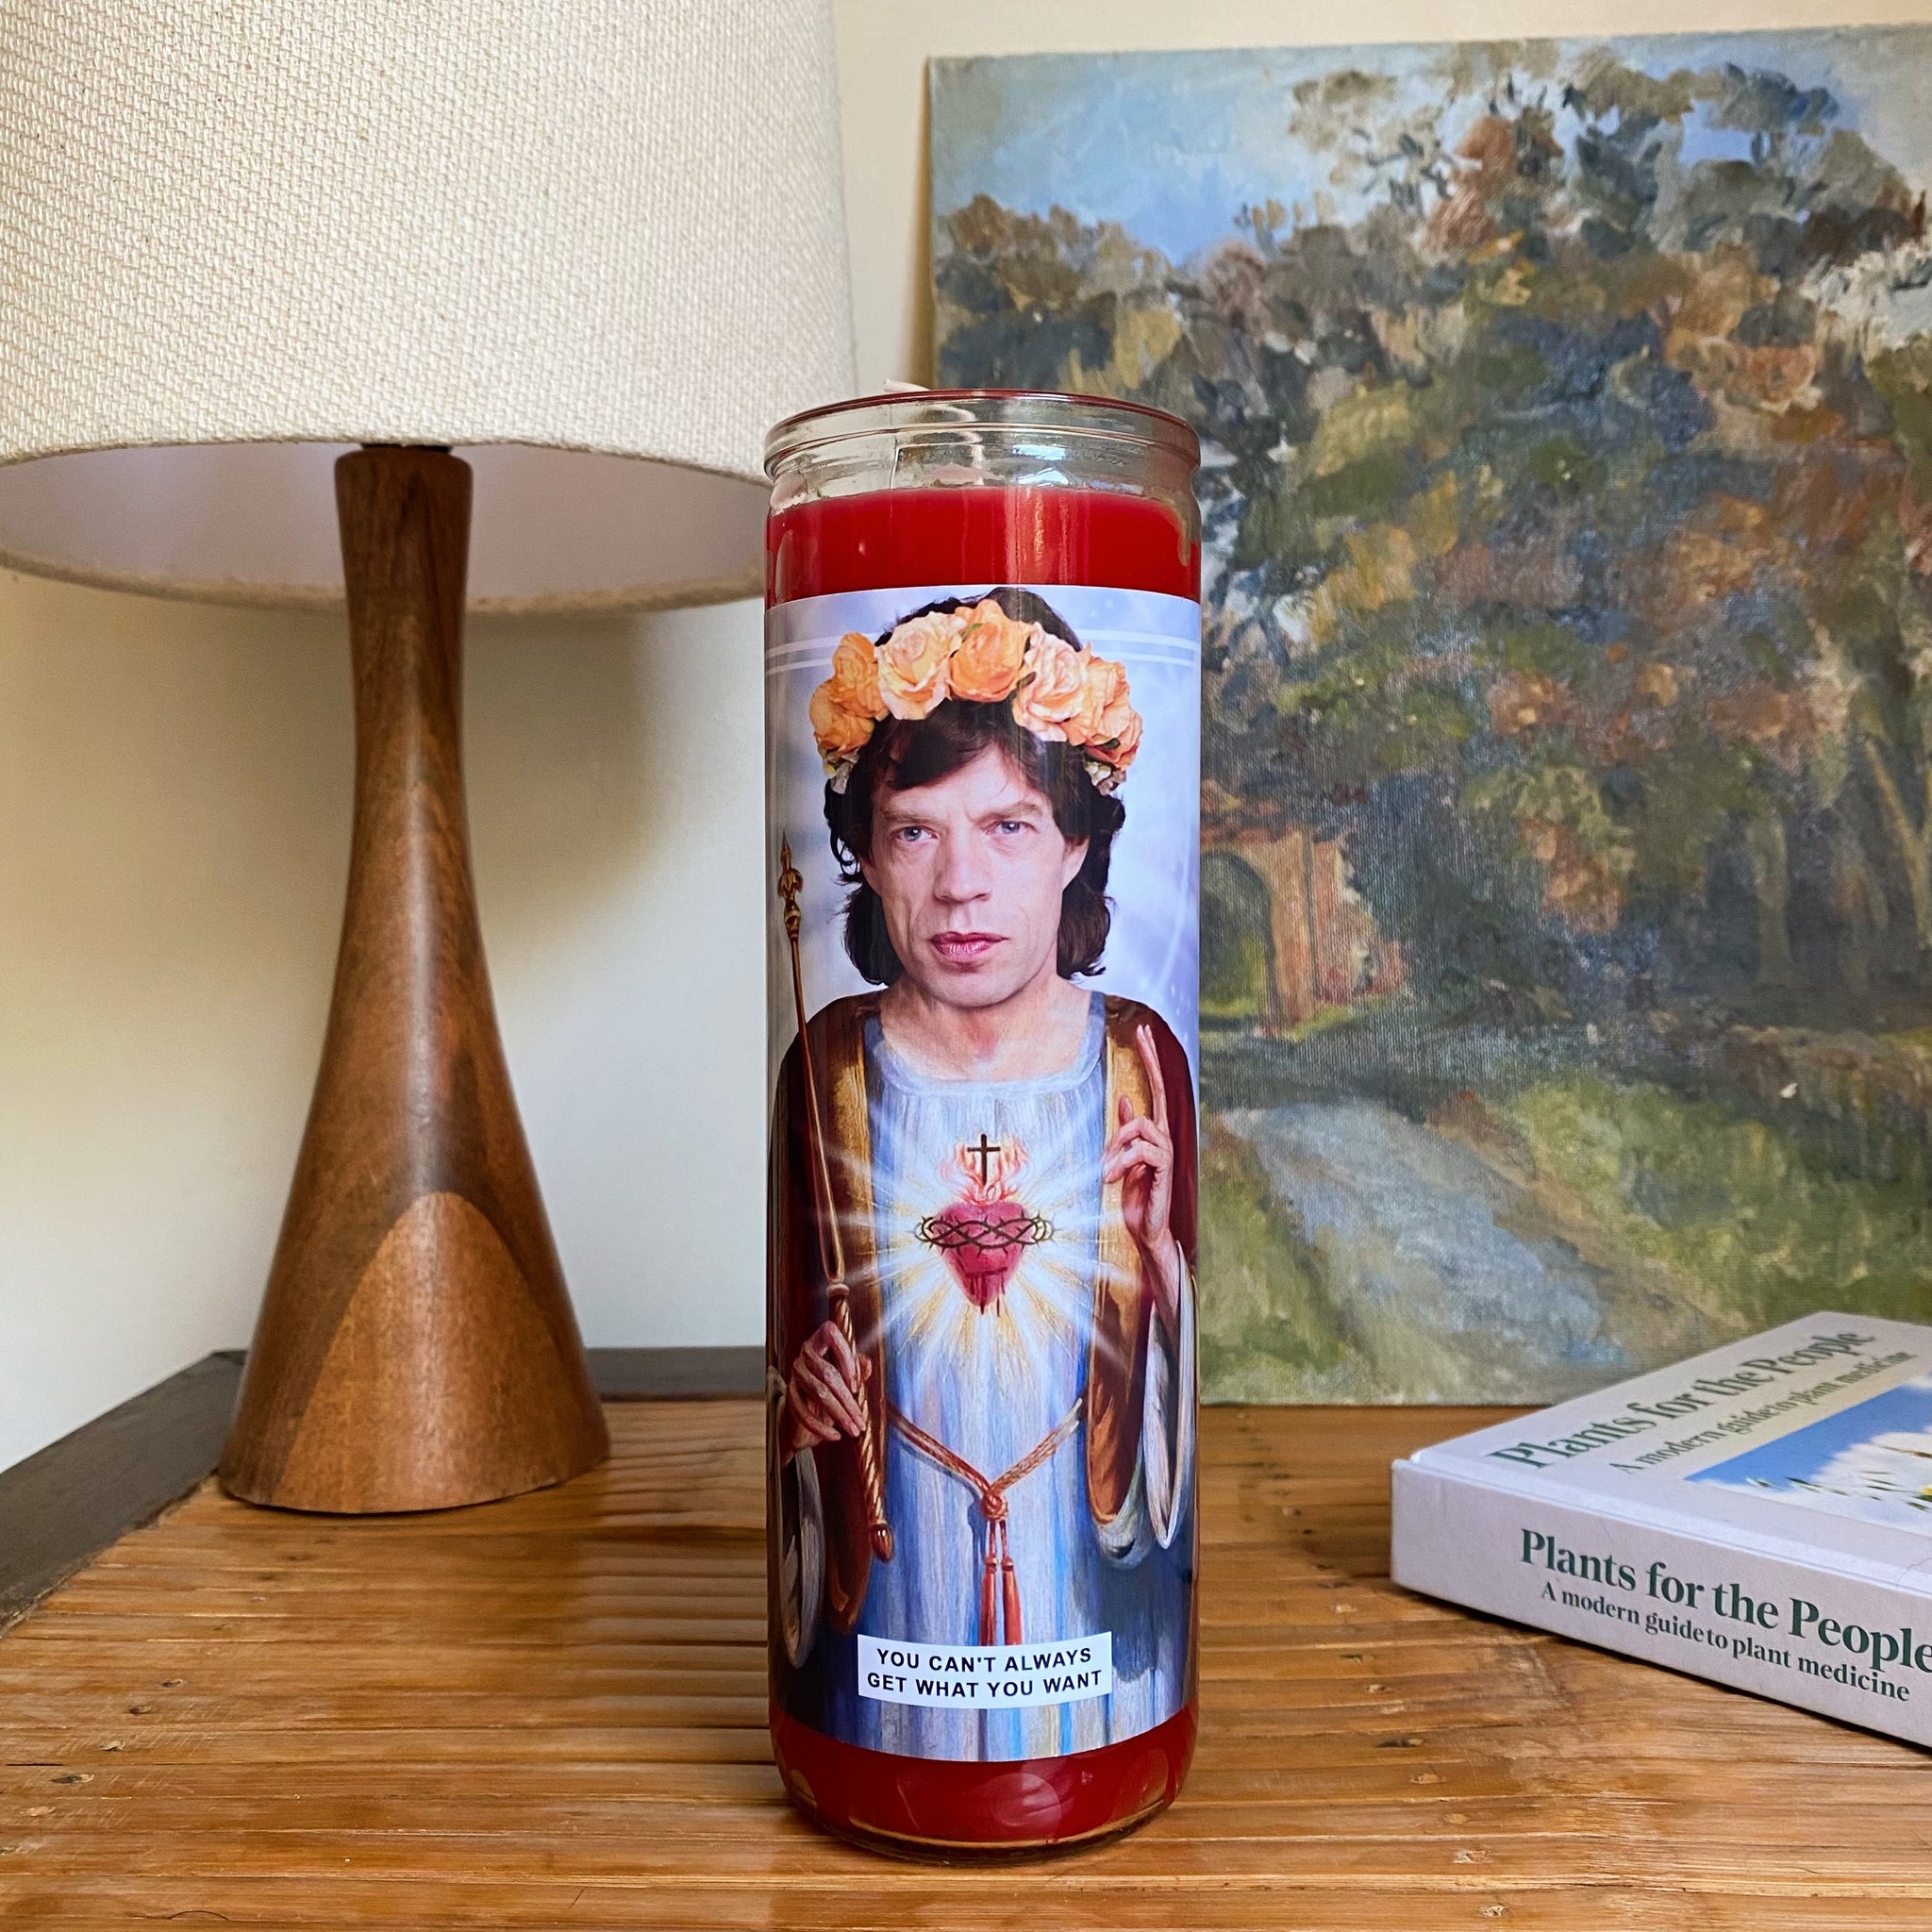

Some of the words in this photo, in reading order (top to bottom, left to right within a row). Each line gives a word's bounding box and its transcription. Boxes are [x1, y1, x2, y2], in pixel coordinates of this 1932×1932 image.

[1485, 1417, 1657, 1469] Plants
[1627, 1393, 1717, 1420] for
[1691, 1369, 1775, 1397] the
[1740, 1332, 1876, 1374] People
[1609, 1461, 1644, 1475] A
[1636, 1429, 1727, 1466] modern
[1521, 1528, 1637, 1591] Plants
[1646, 1561, 1706, 1609] for
[1711, 1583, 1779, 1630] the
[1788, 1597, 1932, 1674] People
[1541, 1581, 1557, 1602] A
[1562, 1591, 1641, 1625] modern
[1644, 1612, 1705, 1643] guide
[1707, 1628, 1728, 1650] to
[1732, 1637, 1791, 1668] plant
[1798, 1656, 1910, 1702] medicine
[867, 1672, 908, 1692] GET
[915, 1678, 979, 1698] WHAT
[987, 1679, 1034, 1697] YOU
[1042, 1670, 1102, 1694] WANT
[876, 1648, 920, 1669] YOU
[928, 1655, 996, 1673] CAN'T
[1004, 1647, 1092, 1672] ALWAYS
